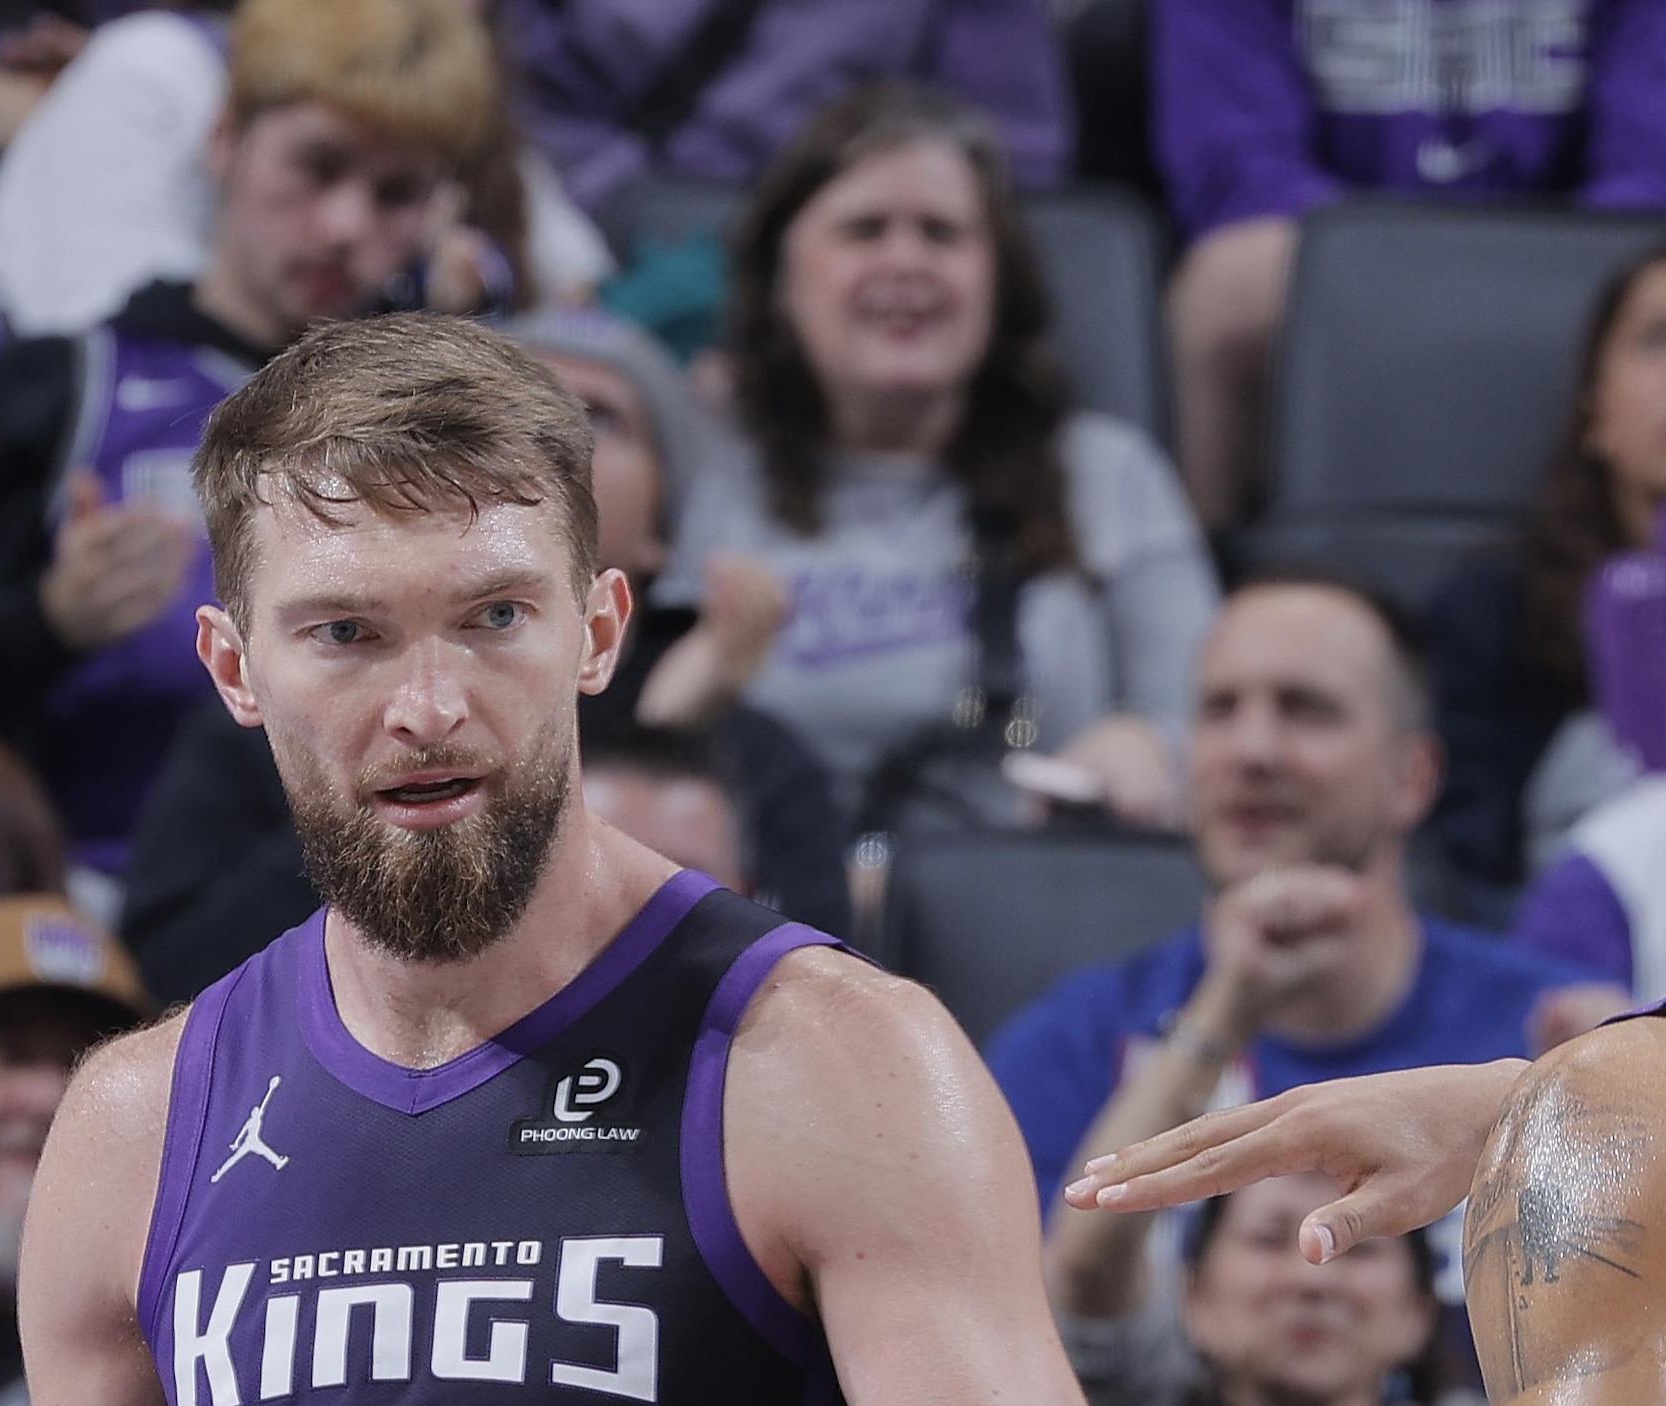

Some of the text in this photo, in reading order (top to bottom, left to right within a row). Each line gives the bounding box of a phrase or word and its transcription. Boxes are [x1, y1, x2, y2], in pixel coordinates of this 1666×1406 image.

[520, 1127, 641, 1143] PHOONG LAW
[269, 1240, 542, 1284] SACRAMENTO
